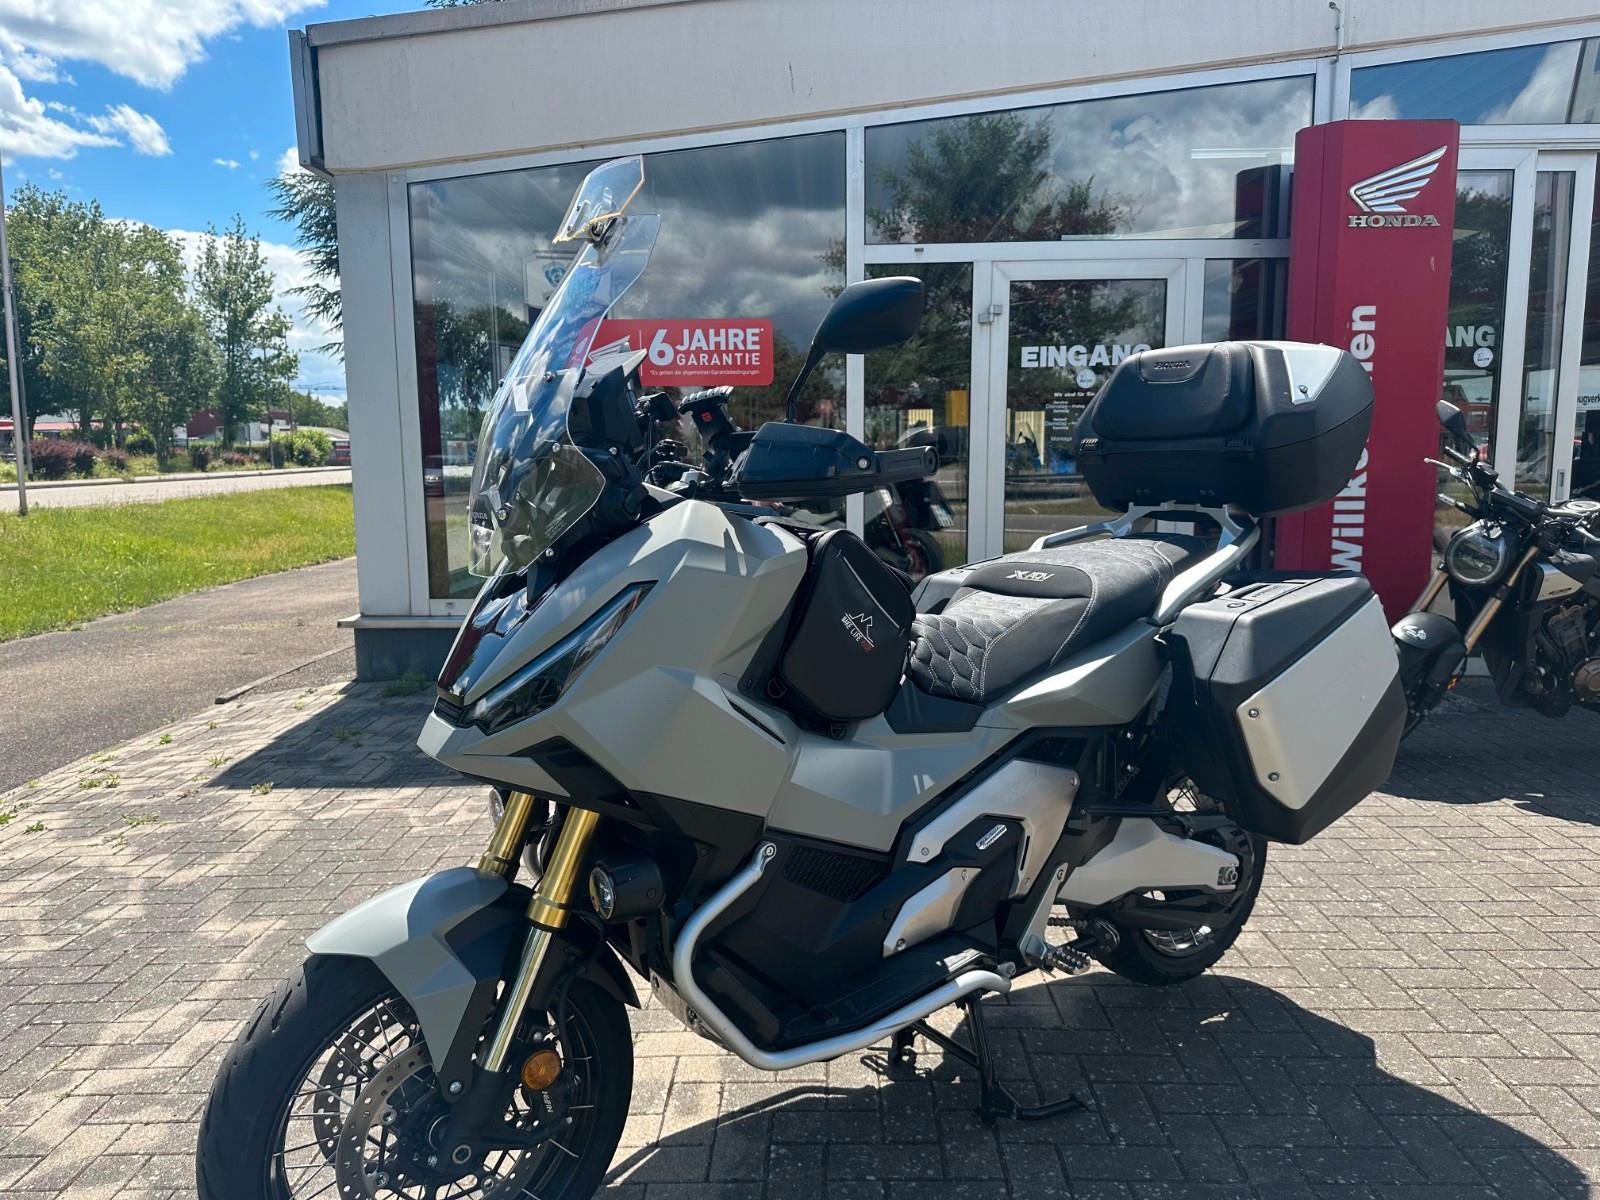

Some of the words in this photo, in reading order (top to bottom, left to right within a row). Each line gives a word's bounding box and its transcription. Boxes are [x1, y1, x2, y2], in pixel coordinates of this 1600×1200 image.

[1347, 214, 1440, 228] HONDA
[648, 329, 674, 366] 6
[676, 352, 761, 366] GARANTIE
[1330, 305, 1377, 573] Willken
[850, 628, 863, 642] LIFE
